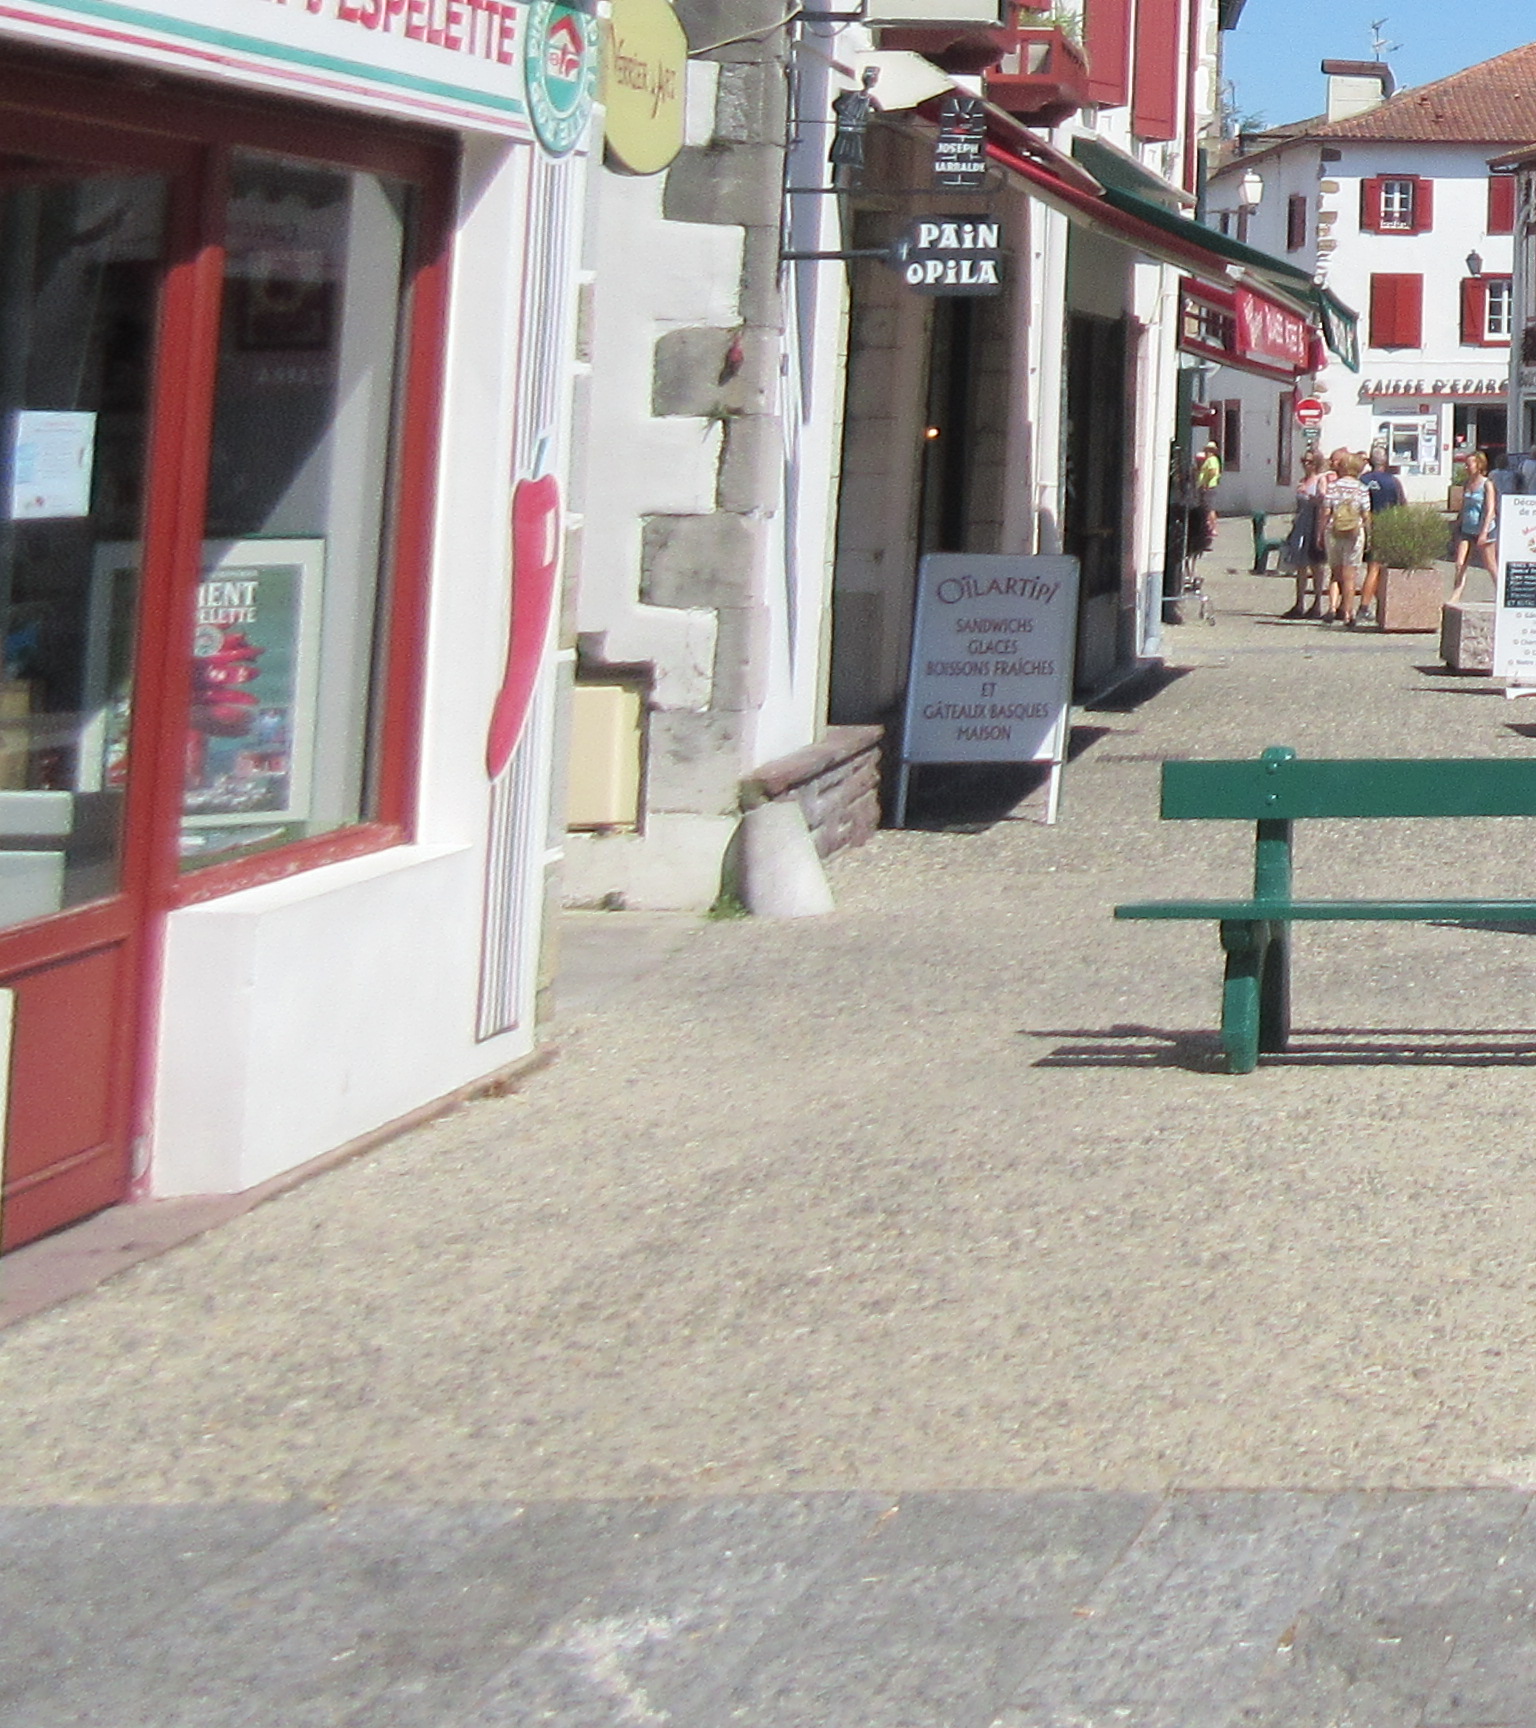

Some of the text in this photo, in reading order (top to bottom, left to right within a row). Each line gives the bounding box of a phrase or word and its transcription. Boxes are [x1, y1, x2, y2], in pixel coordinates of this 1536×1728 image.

[935, 142, 979, 154] JOSEPH
[1519, 508, 1529, 516] de
[967, 639, 1018, 655] GLACES
[926, 660, 990, 676] BOISSONS
[981, 682, 997, 698] ET
[990, 703, 1050, 720] BASQUES
[956, 726, 1011, 741] MAISON
